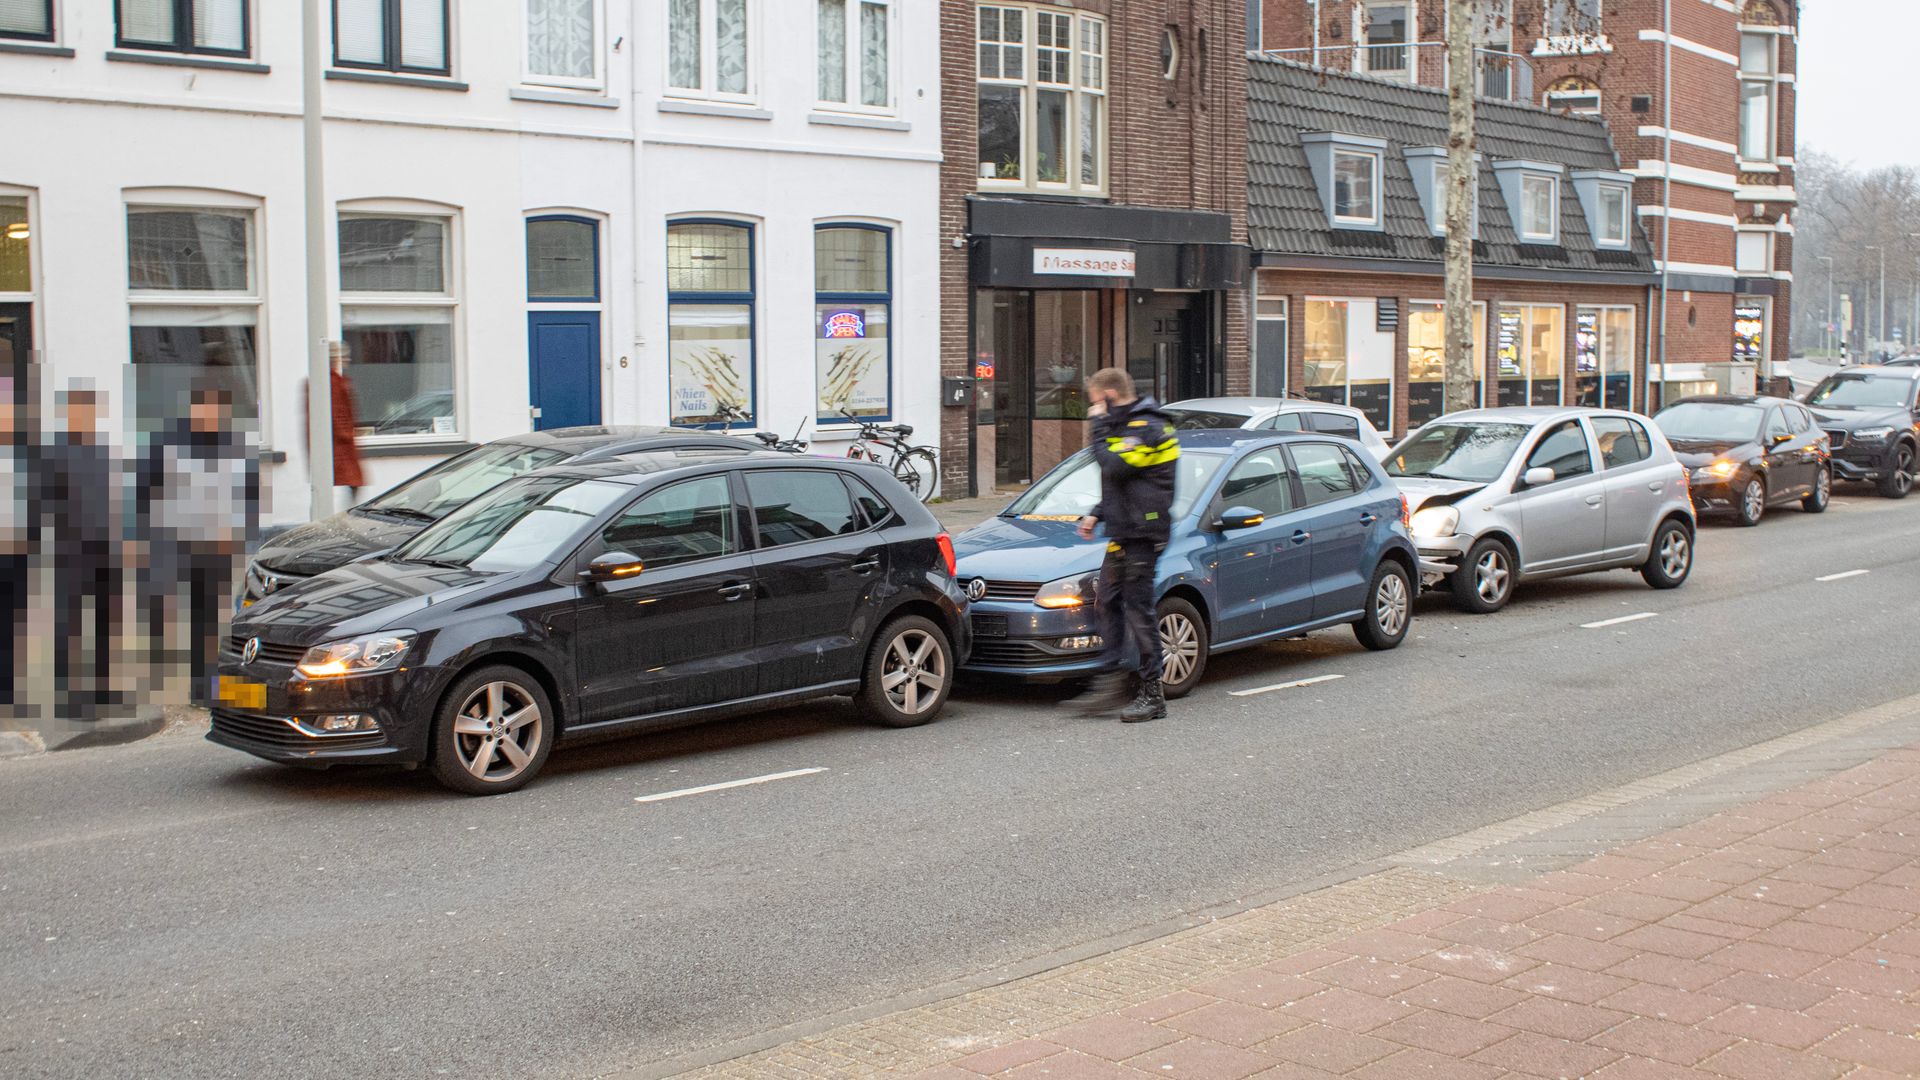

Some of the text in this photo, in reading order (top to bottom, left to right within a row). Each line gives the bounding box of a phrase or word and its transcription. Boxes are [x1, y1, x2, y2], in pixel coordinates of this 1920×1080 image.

[1043, 256, 1118, 271] Massage
[832, 313, 858, 326] NAILS
[832, 326, 857, 338] OPEN
[620, 355, 629, 368] 6
[674, 387, 705, 399] Nhien
[679, 400, 707, 411] Nails
